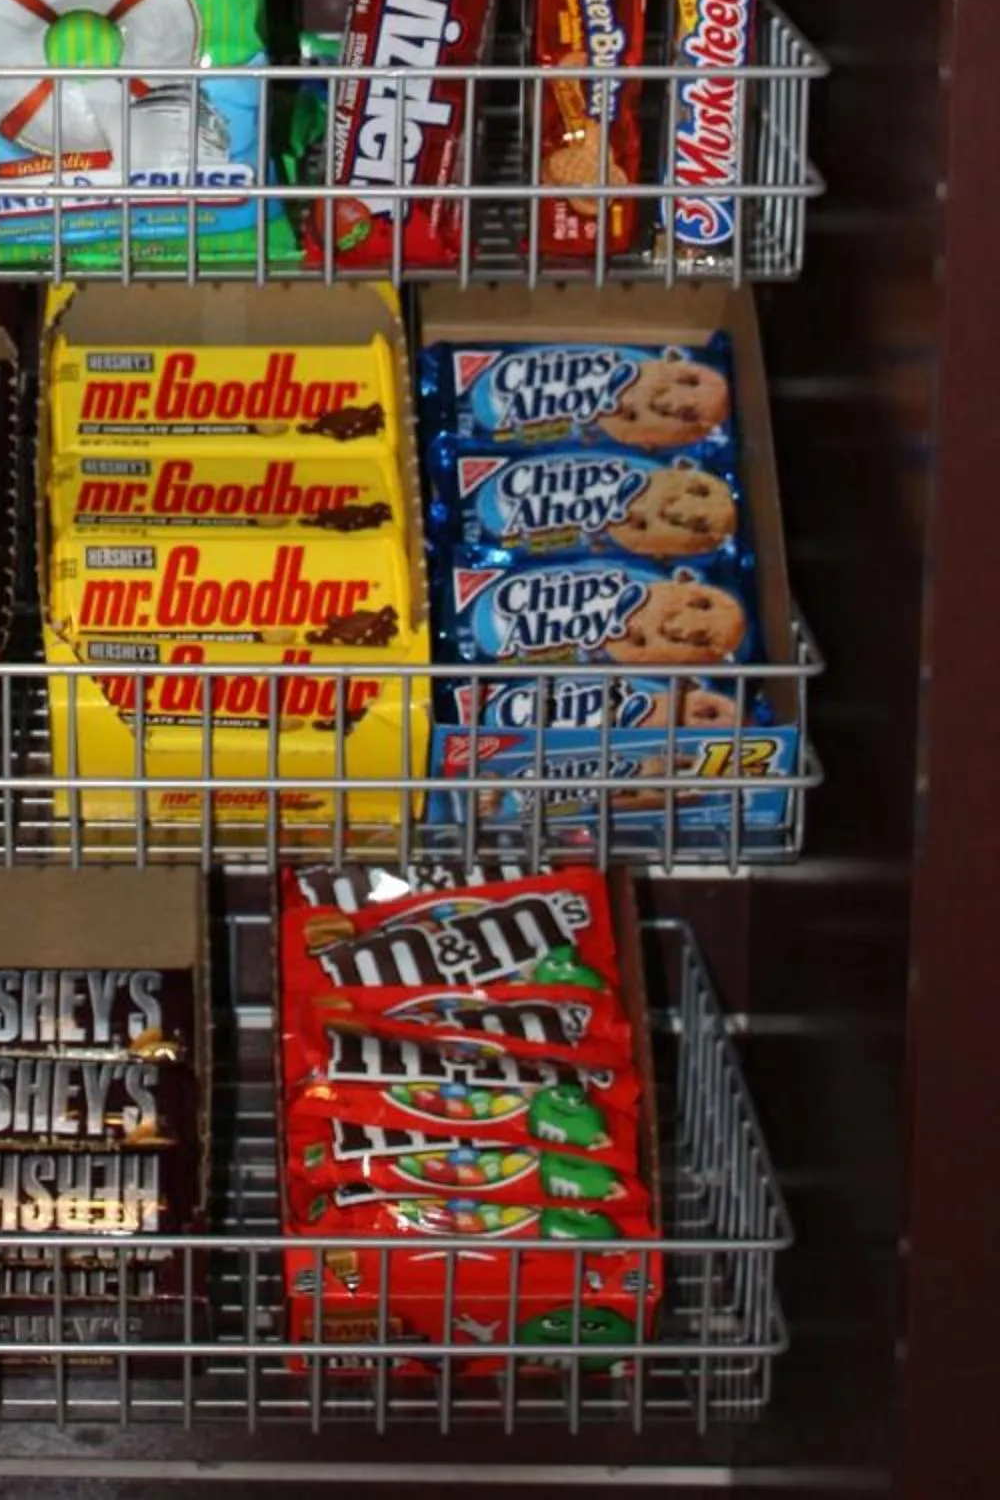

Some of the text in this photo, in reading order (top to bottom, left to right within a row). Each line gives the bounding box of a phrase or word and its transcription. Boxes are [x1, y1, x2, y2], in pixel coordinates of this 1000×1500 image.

[588, 29, 626, 123] Buter
[674, 196, 719, 238] 3
[80, 352, 360, 421] mr. Goodbar
[495, 352, 613, 393] Chips
[497, 361, 636, 426] Ahoy!
[75, 460, 360, 515] mr. Goodbar
[502, 459, 622, 497] Chips
[504, 470, 643, 533] Ahoy!
[79, 545, 370, 627] mr. Goodbar
[498, 571, 623, 615] Chips
[502, 583, 645, 651] Ahoy!
[501, 686, 605, 726] Cip
